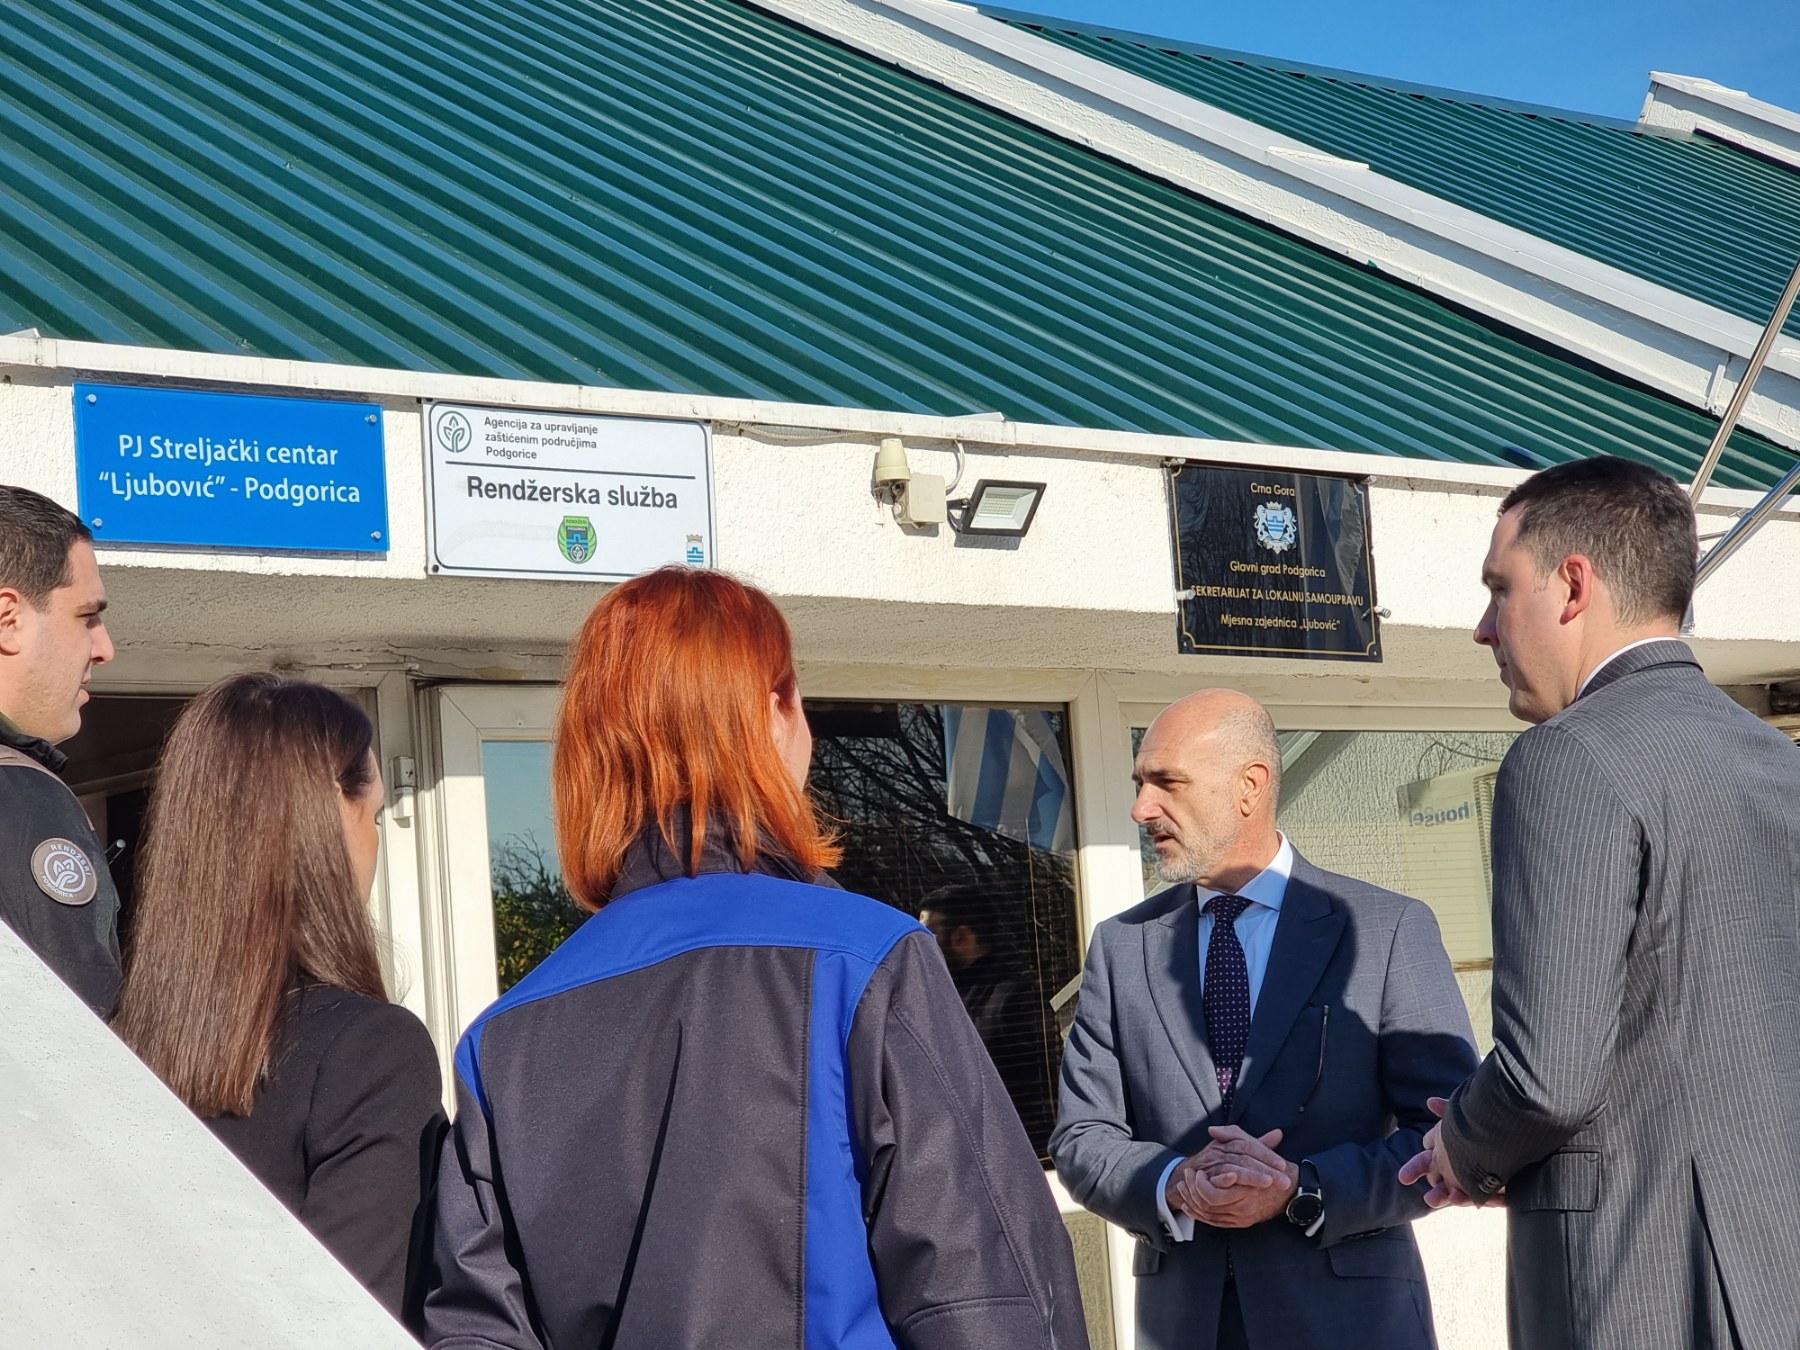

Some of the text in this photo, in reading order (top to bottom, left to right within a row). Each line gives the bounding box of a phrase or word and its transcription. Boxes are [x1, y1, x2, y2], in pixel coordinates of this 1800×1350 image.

[484, 416, 599, 436] Agencija za upravljanje
[485, 430, 597, 450] zaštićenim područjima
[119, 434, 338, 467] PJ Streljački centar
[486, 446, 538, 461] Podgorice
[244, 477, 361, 508] Podgorica
[467, 475, 678, 509] Rendžerska služba
[1250, 482, 1295, 497] Crna Gora
[1230, 560, 1326, 579] Glavni grad Podgorica
[1191, 585, 1364, 606] SEKRETARIJAT ZA LOKALNU SAMOUPRAVU
[1221, 613, 1253, 628] Mjesna
[1254, 615, 1297, 629] zajednica
